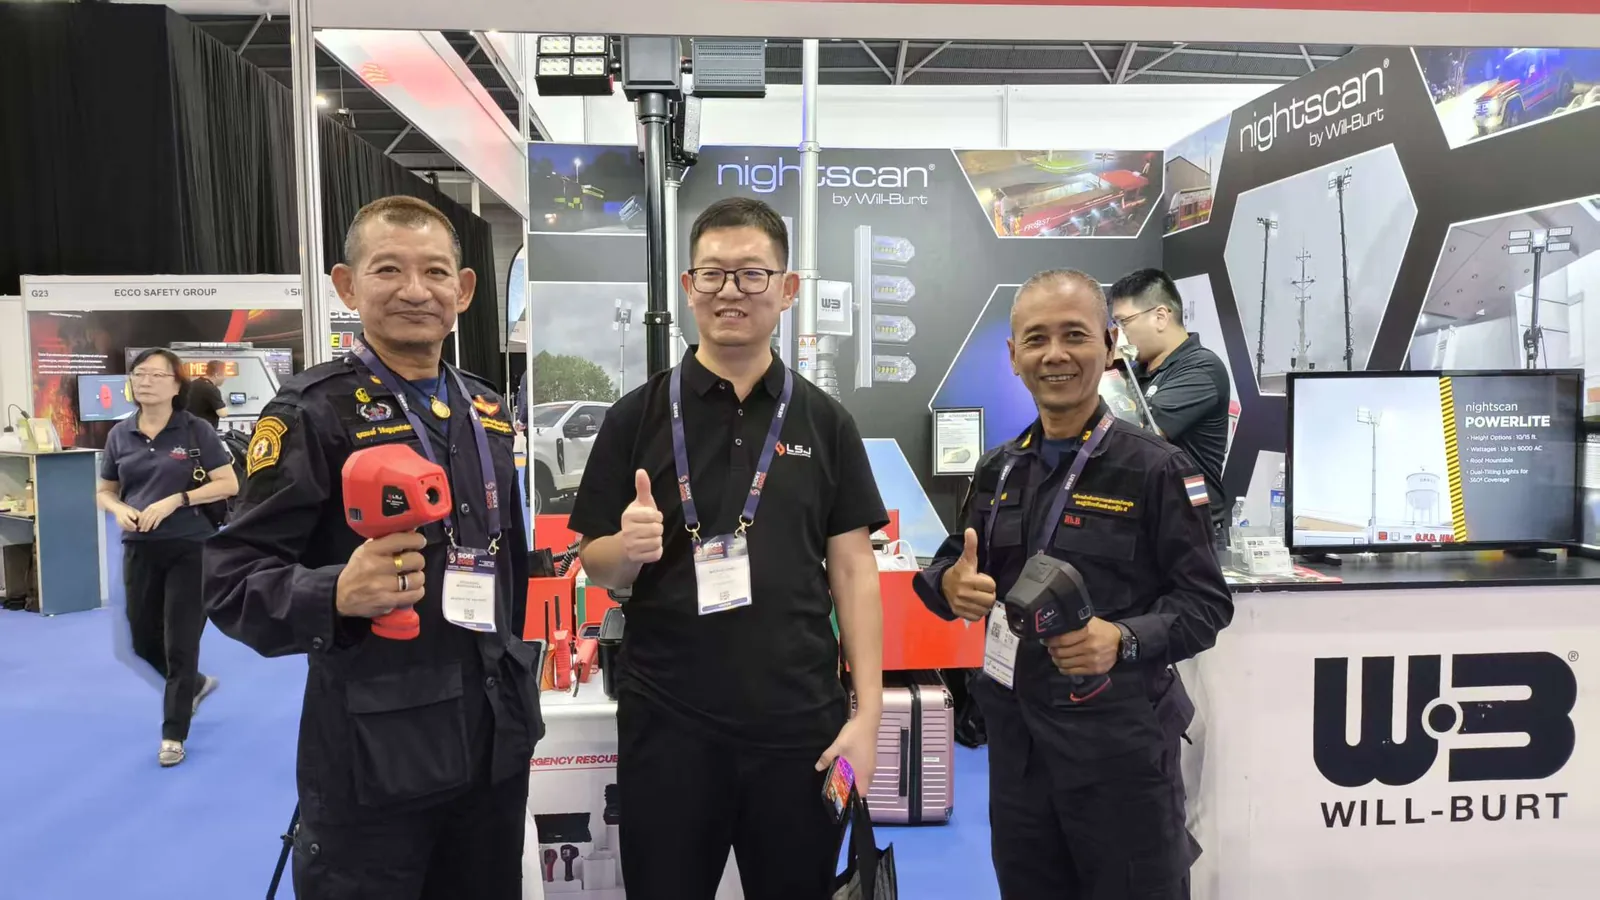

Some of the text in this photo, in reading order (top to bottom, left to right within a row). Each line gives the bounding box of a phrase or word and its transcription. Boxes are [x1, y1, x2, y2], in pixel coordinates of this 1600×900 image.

[1309, 108, 1384, 147] by Will-Burt
[832, 193, 928, 207] by Will-Burt
[31, 290, 49, 298] G23
[114, 288, 217, 297] ECCO SAFETY GROUP
[1465, 401, 1518, 413] nightscan
[1465, 415, 1551, 428] POWERLITE
[786, 443, 811, 455] LSJ
[529, 756, 575, 767] RGENCY
[1320, 792, 1569, 828] WILL-BURT
